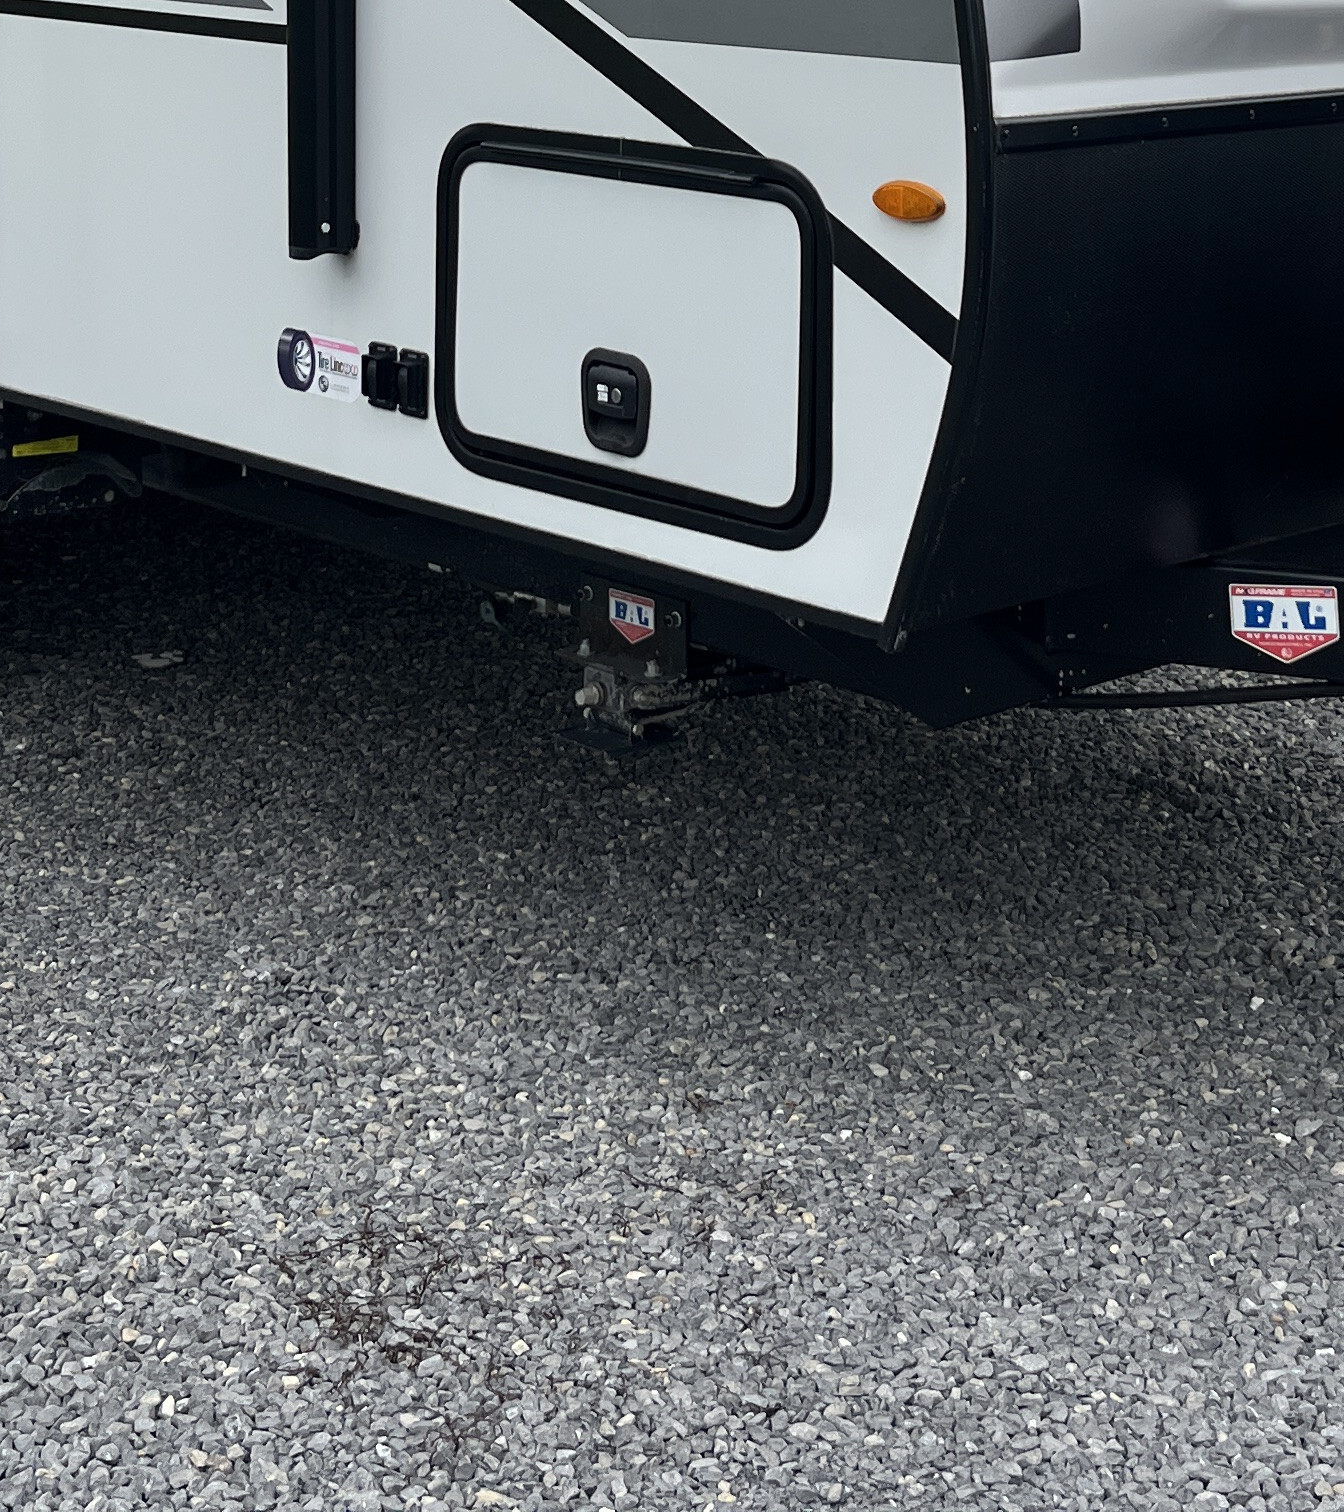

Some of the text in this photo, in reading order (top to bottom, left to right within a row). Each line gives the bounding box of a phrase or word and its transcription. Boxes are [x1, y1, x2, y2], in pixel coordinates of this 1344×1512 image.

[317, 351, 329, 370] Tire
[1242, 599, 1326, 630] BAL
[1264, 633, 1325, 641] PRODUCTS
